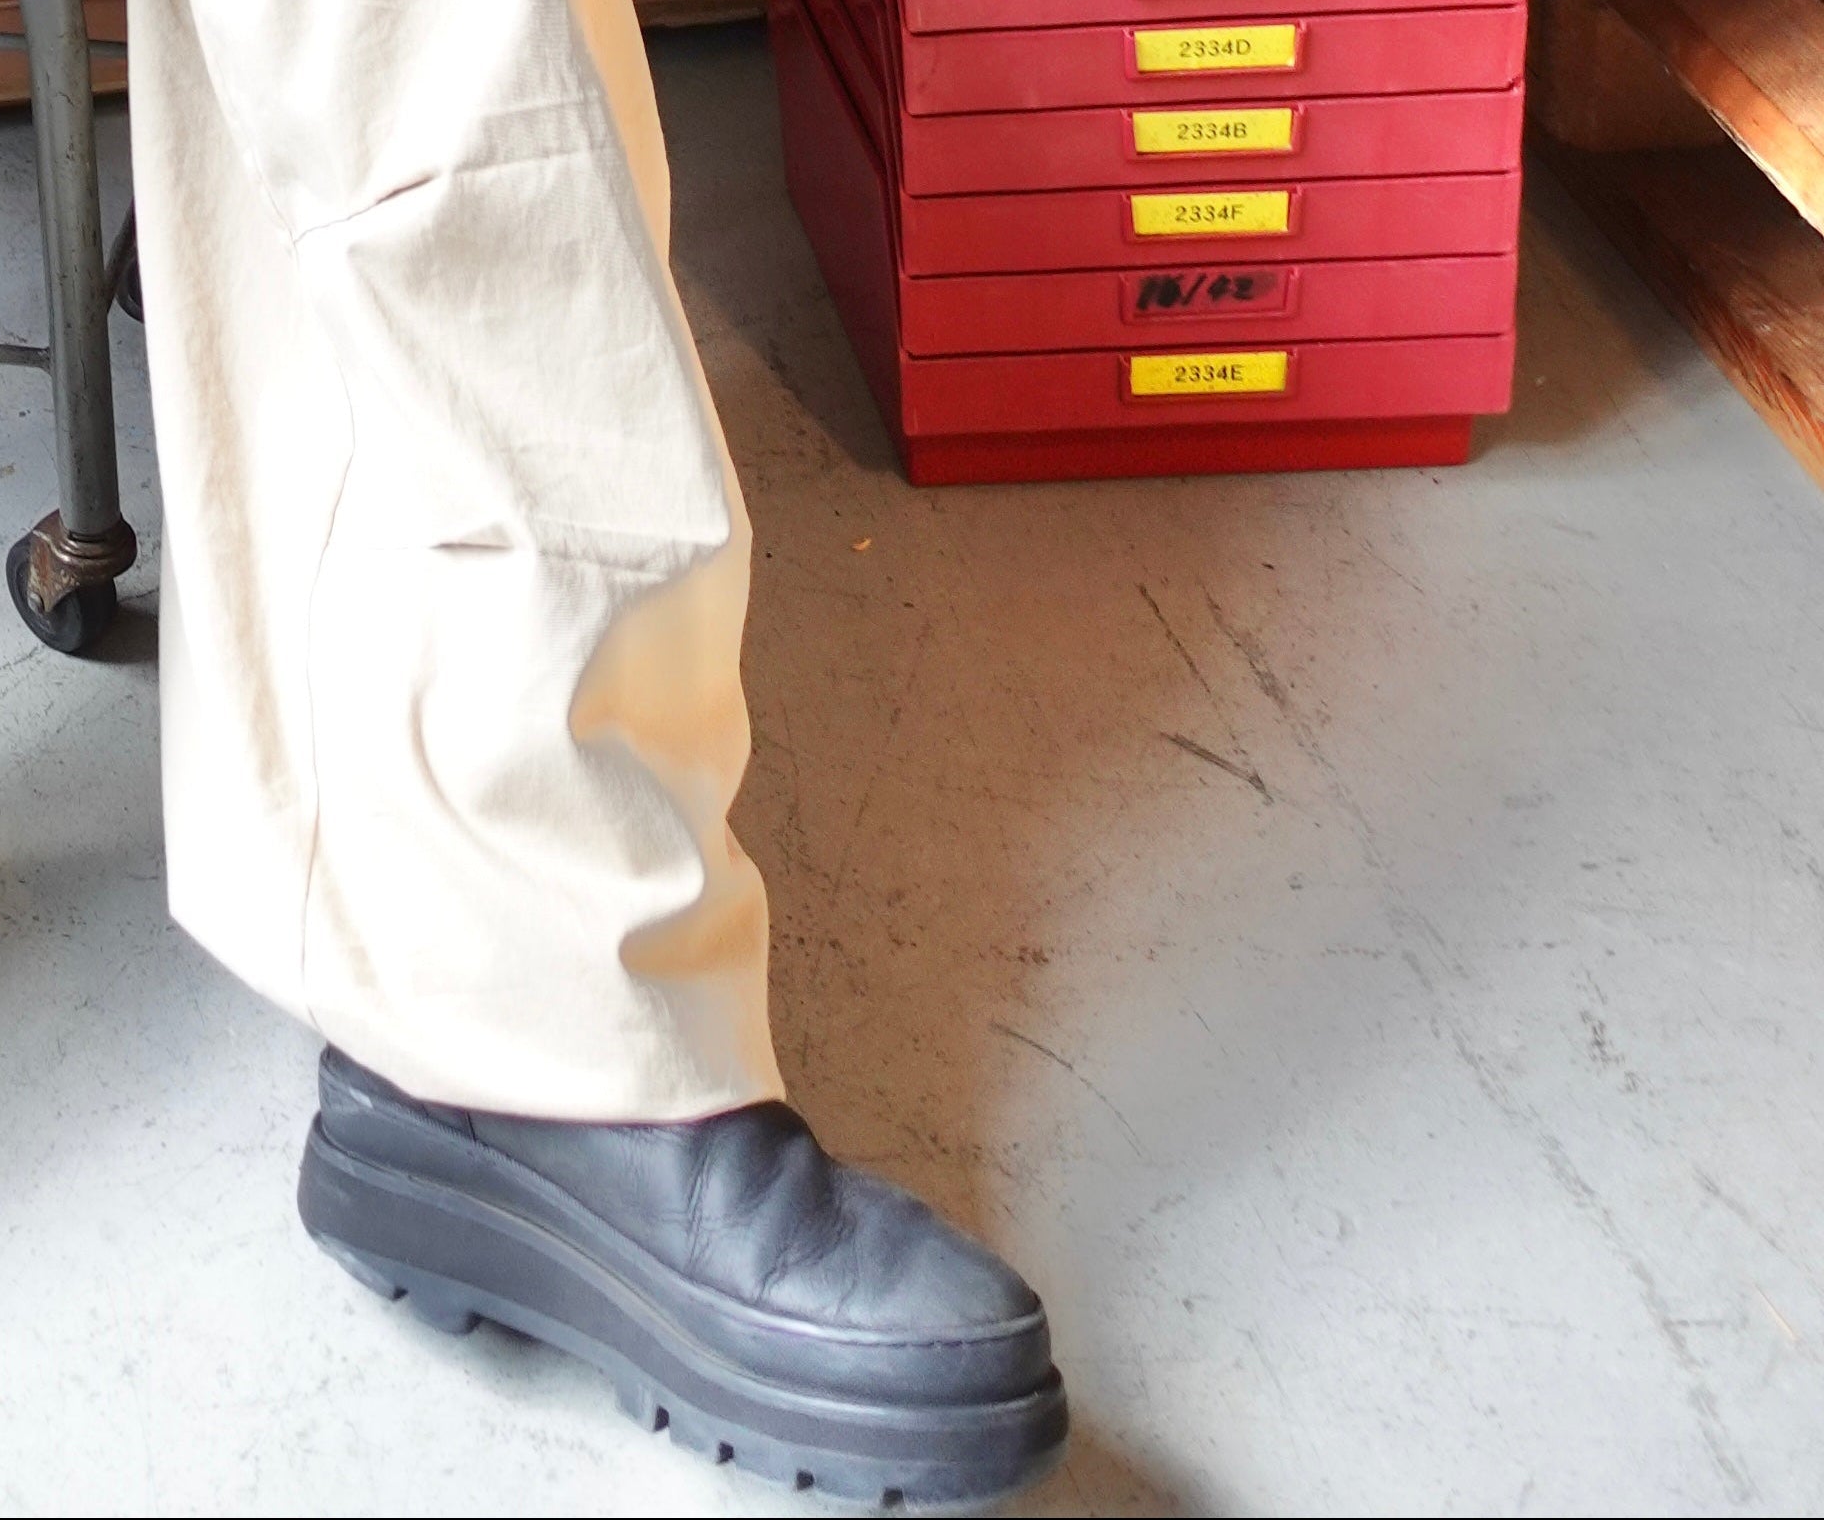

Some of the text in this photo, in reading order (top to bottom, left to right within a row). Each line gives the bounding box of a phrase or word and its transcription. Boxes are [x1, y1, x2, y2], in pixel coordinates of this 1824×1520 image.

[1177, 38, 1253, 58] 2334D
[1176, 121, 1247, 141] 2334B
[1174, 204, 1245, 224] 2334F
[1174, 364, 1245, 384] 2334E
